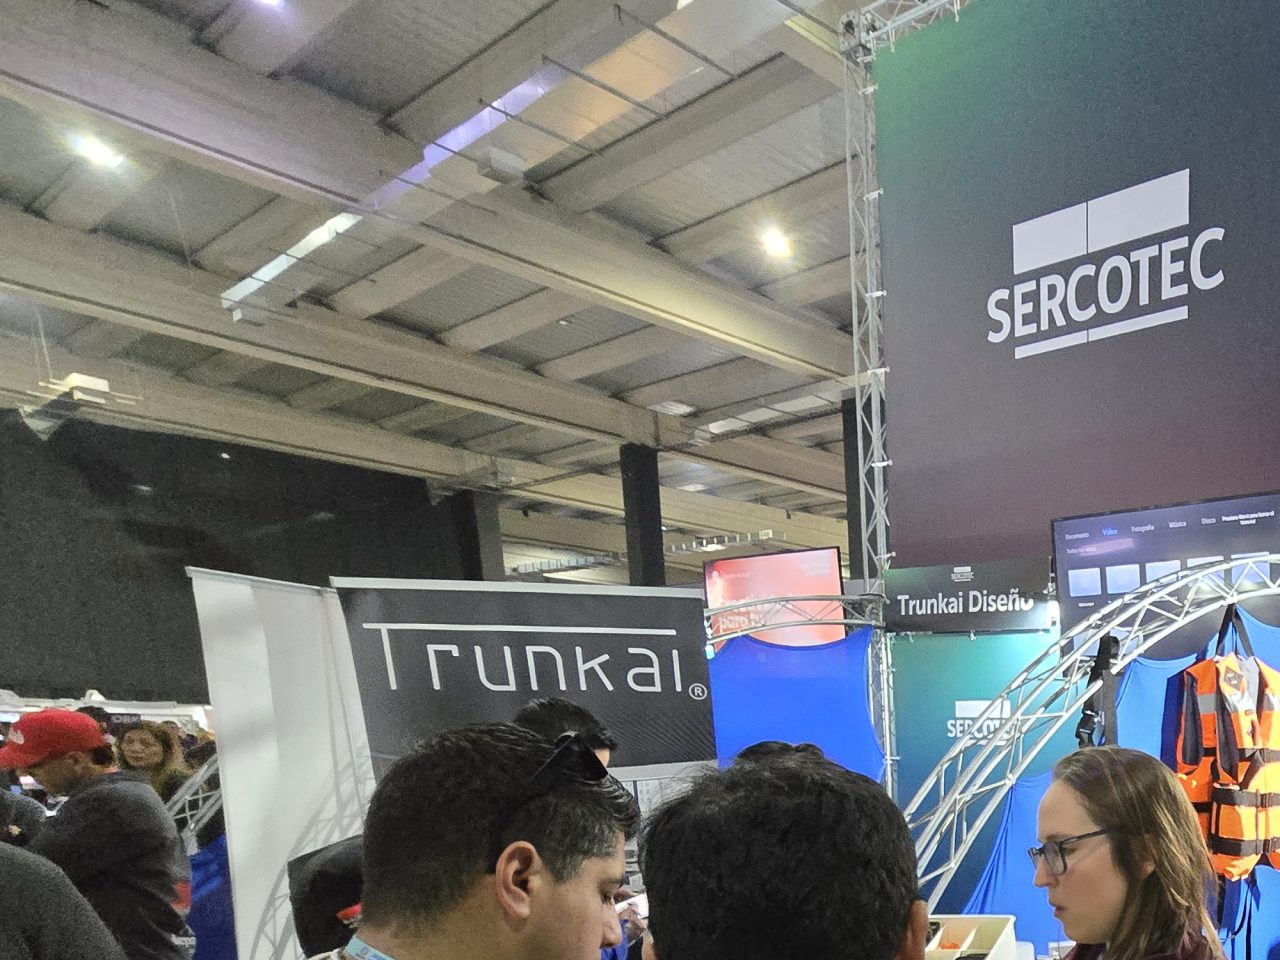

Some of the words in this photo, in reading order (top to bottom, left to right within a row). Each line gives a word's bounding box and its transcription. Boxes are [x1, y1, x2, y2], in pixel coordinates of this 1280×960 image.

[986, 226, 1225, 344] SERCOTEC
[896, 591, 963, 616] Trunkai
[968, 587, 1035, 613] Diseño
